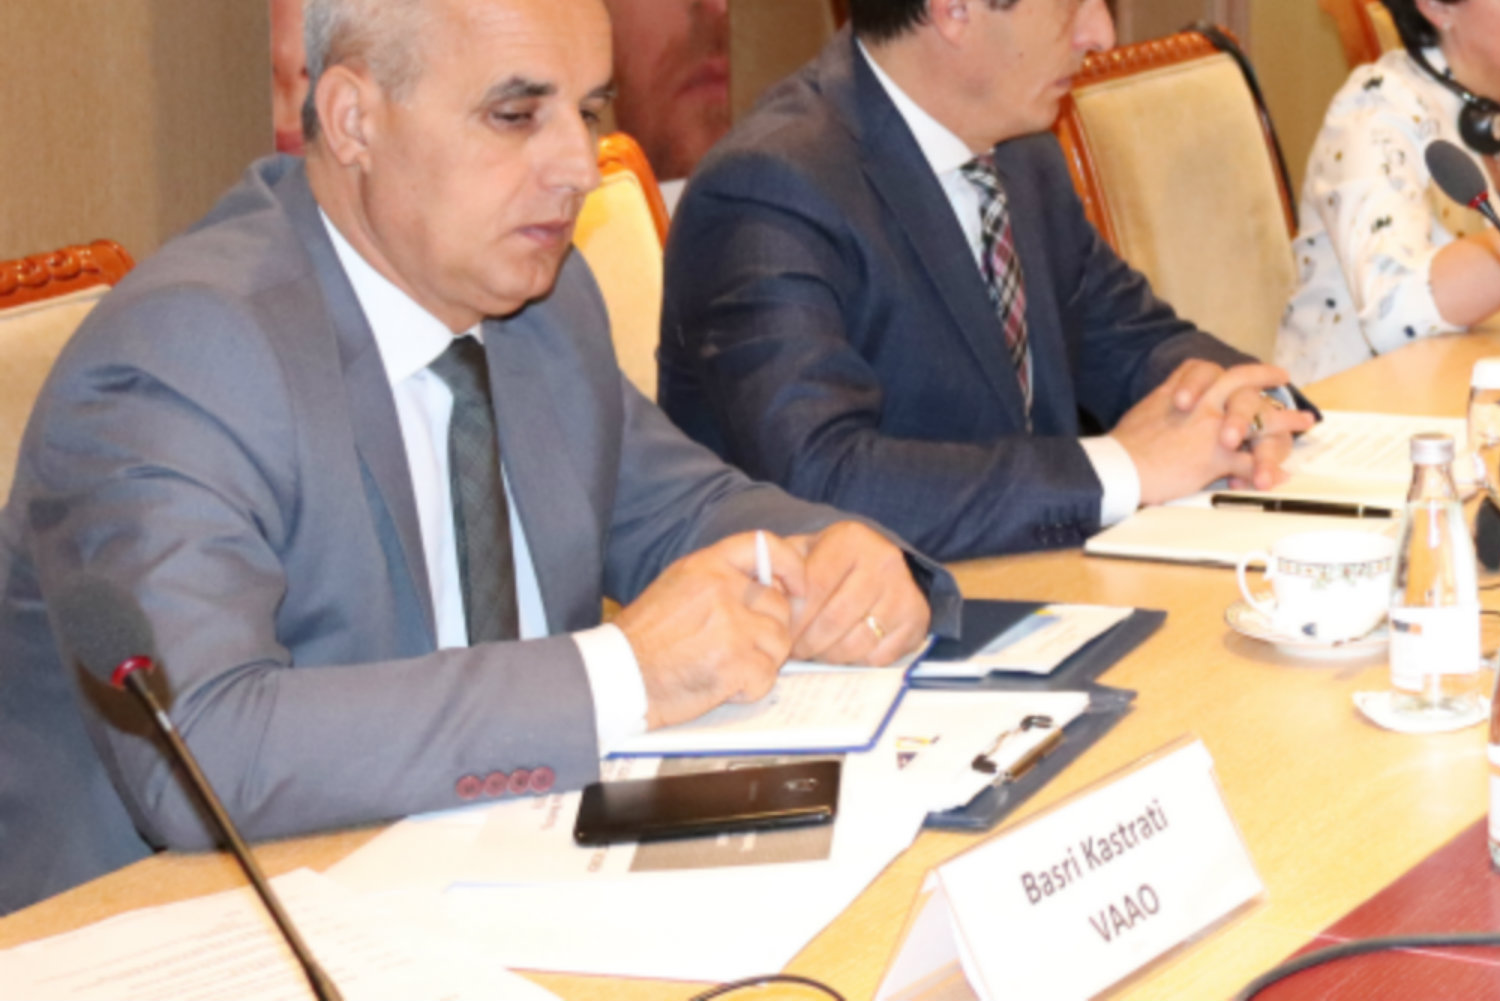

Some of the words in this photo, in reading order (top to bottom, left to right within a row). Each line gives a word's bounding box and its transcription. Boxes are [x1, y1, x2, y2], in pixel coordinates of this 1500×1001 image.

[1020, 846, 1082, 905] Basri
[1081, 798, 1170, 873] Kastrati
[1088, 882, 1161, 943] VAAO
